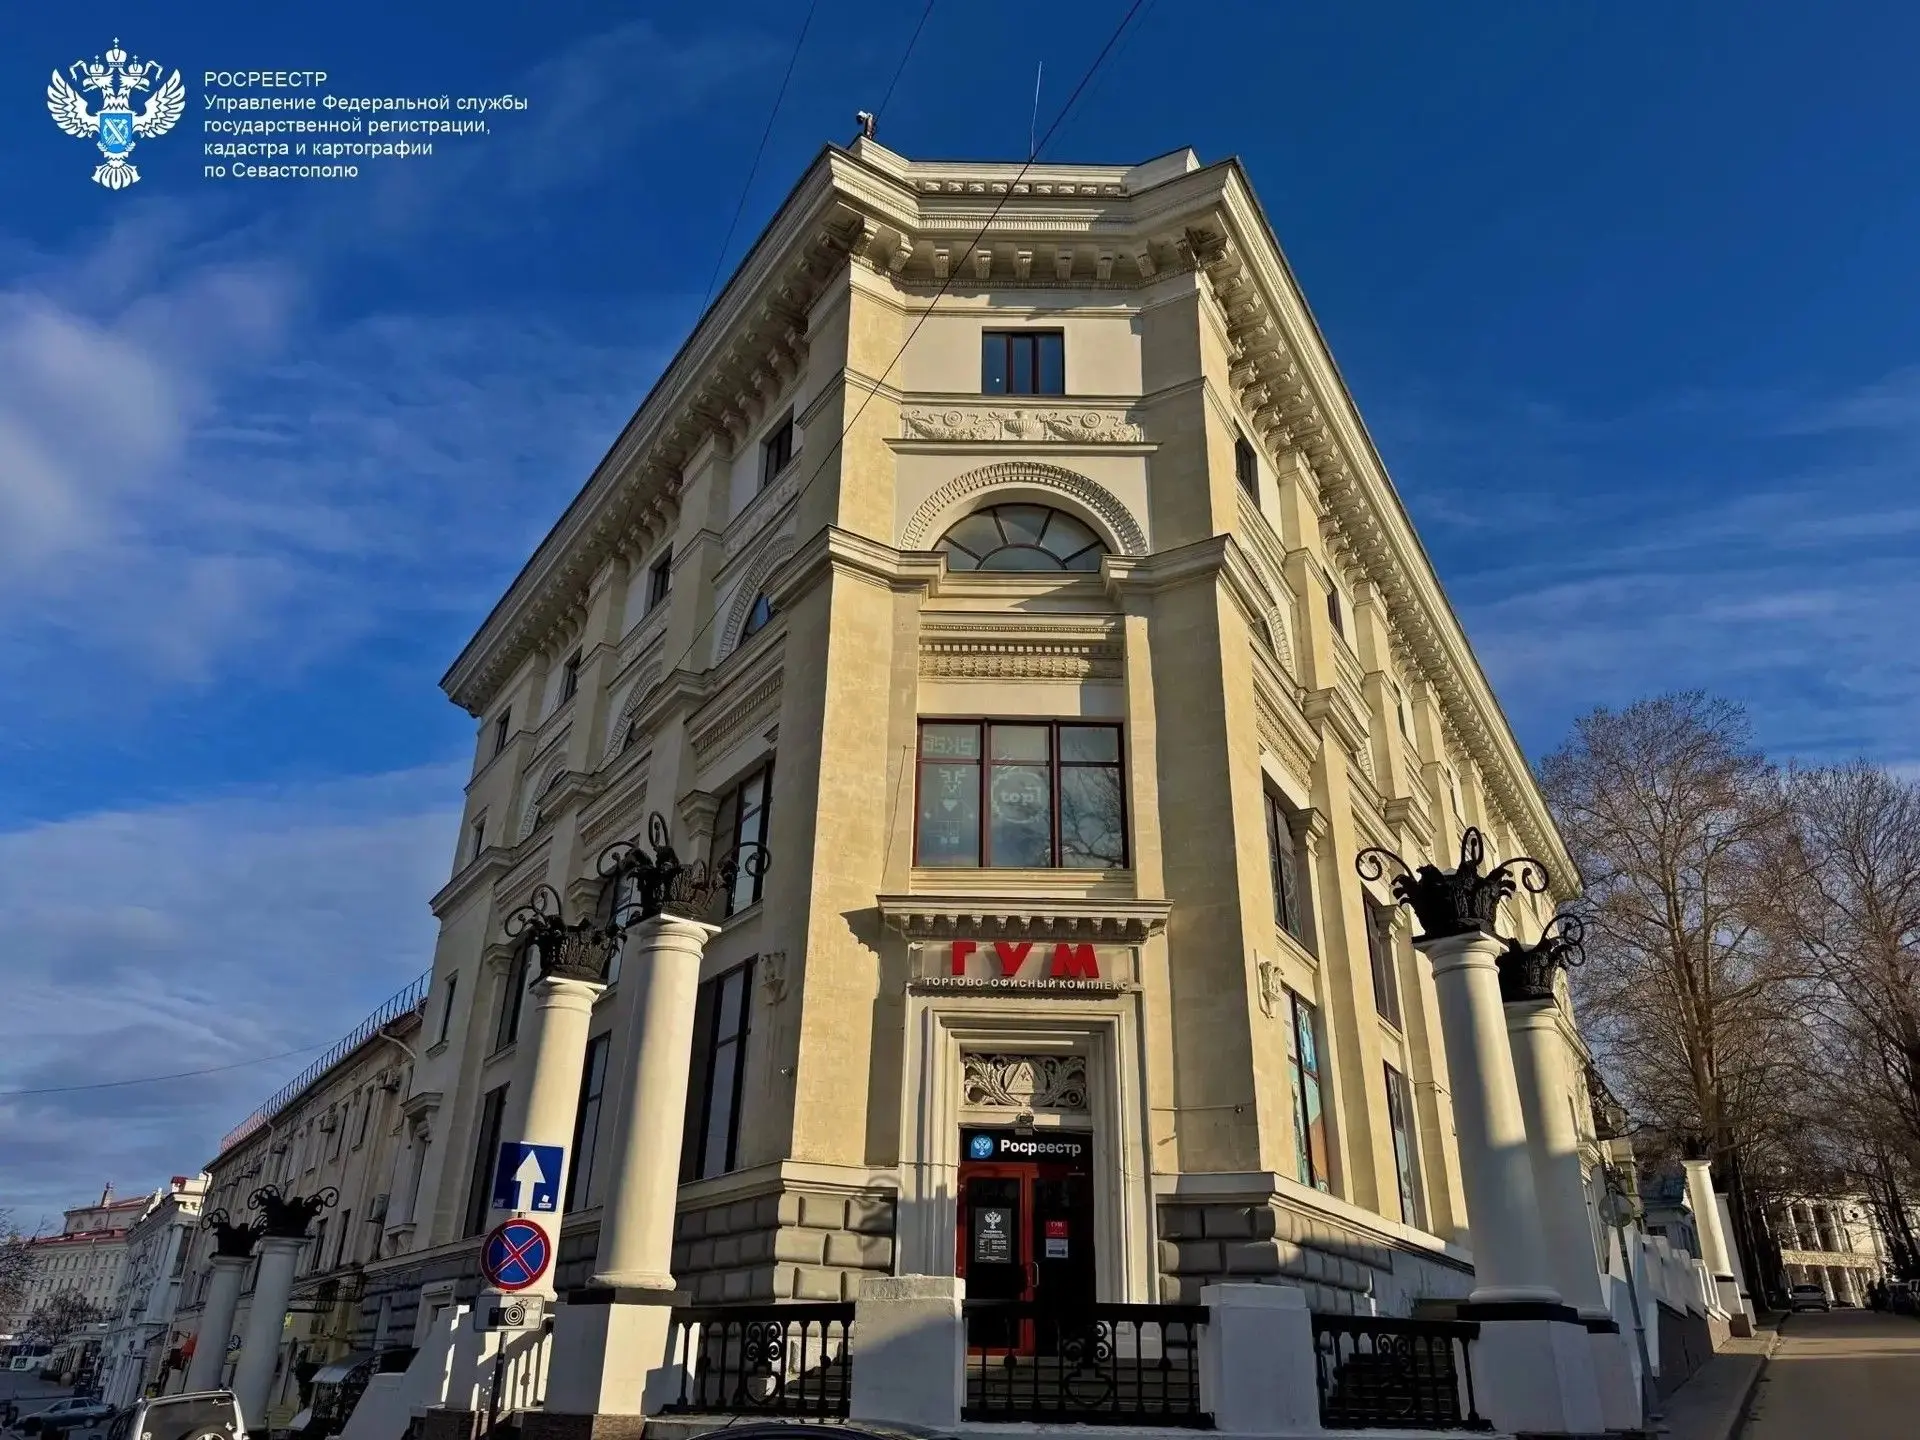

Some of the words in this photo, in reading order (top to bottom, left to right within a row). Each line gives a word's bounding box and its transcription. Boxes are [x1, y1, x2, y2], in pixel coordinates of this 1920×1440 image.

[952, 941, 1100, 978] ГУМ
[925, 977, 1056, 989] ТОРГОВО-ОФИСНЫЙ
[1060, 979, 1129, 990] КОМПЛЕКС
[1000, 1139, 1082, 1157] Росреестр
